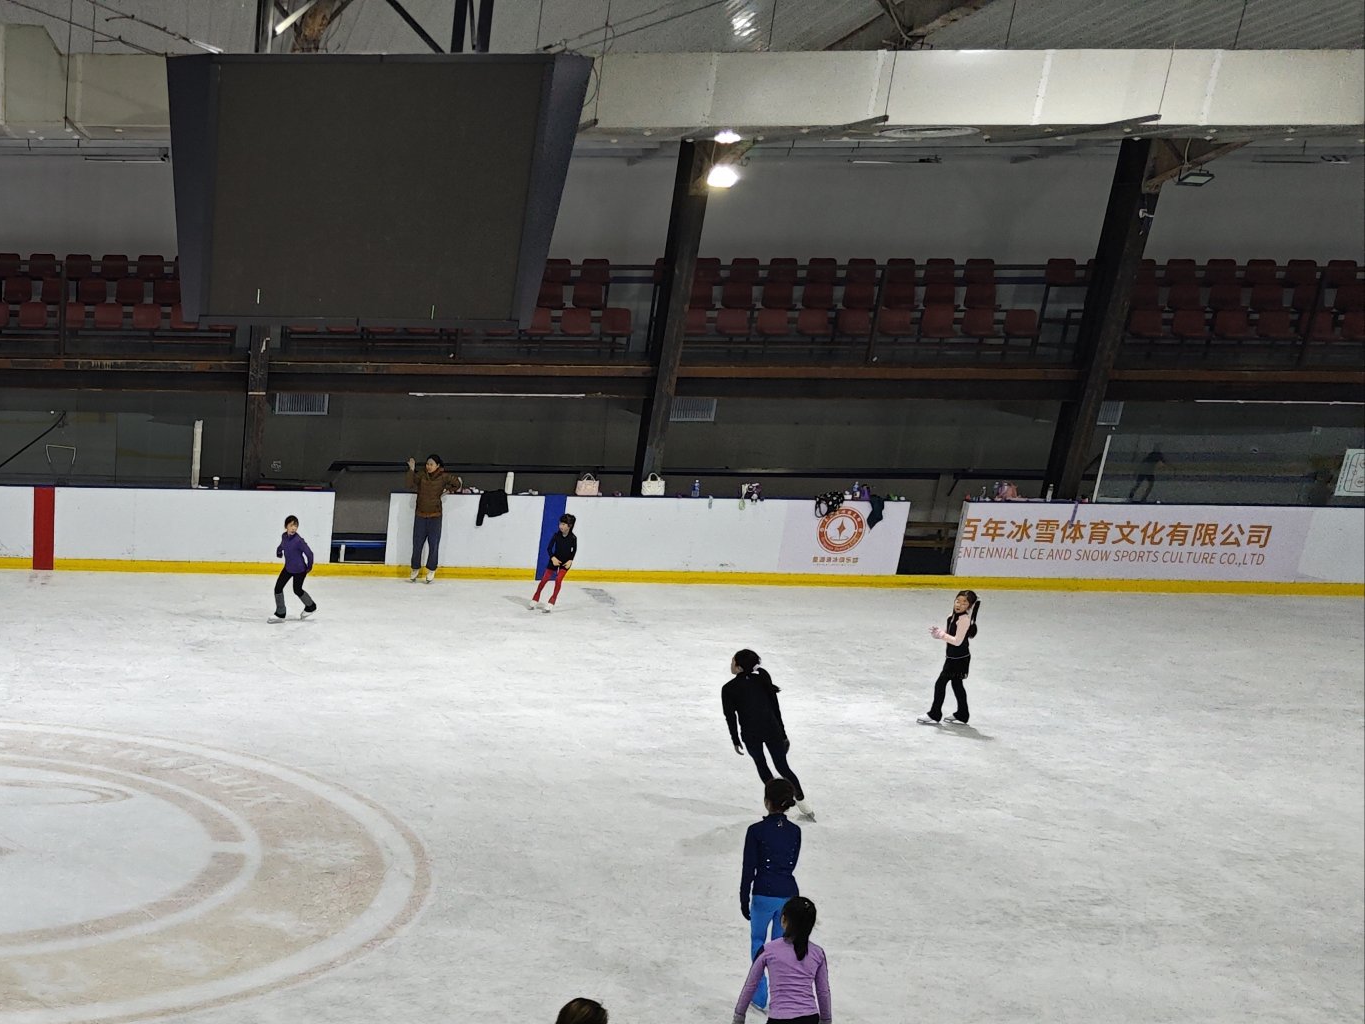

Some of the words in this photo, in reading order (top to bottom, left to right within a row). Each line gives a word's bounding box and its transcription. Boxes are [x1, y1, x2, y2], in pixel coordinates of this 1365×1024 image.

[962, 517, 1273, 549] 百年冰雪体育文化有限公司
[1022, 548, 1044, 560] LCE
[1046, 549, 1072, 561] AND
[1074, 549, 1111, 562] SNOW
[1113, 550, 1160, 563] SPORTS
[1161, 551, 1217, 564] CULTURE
